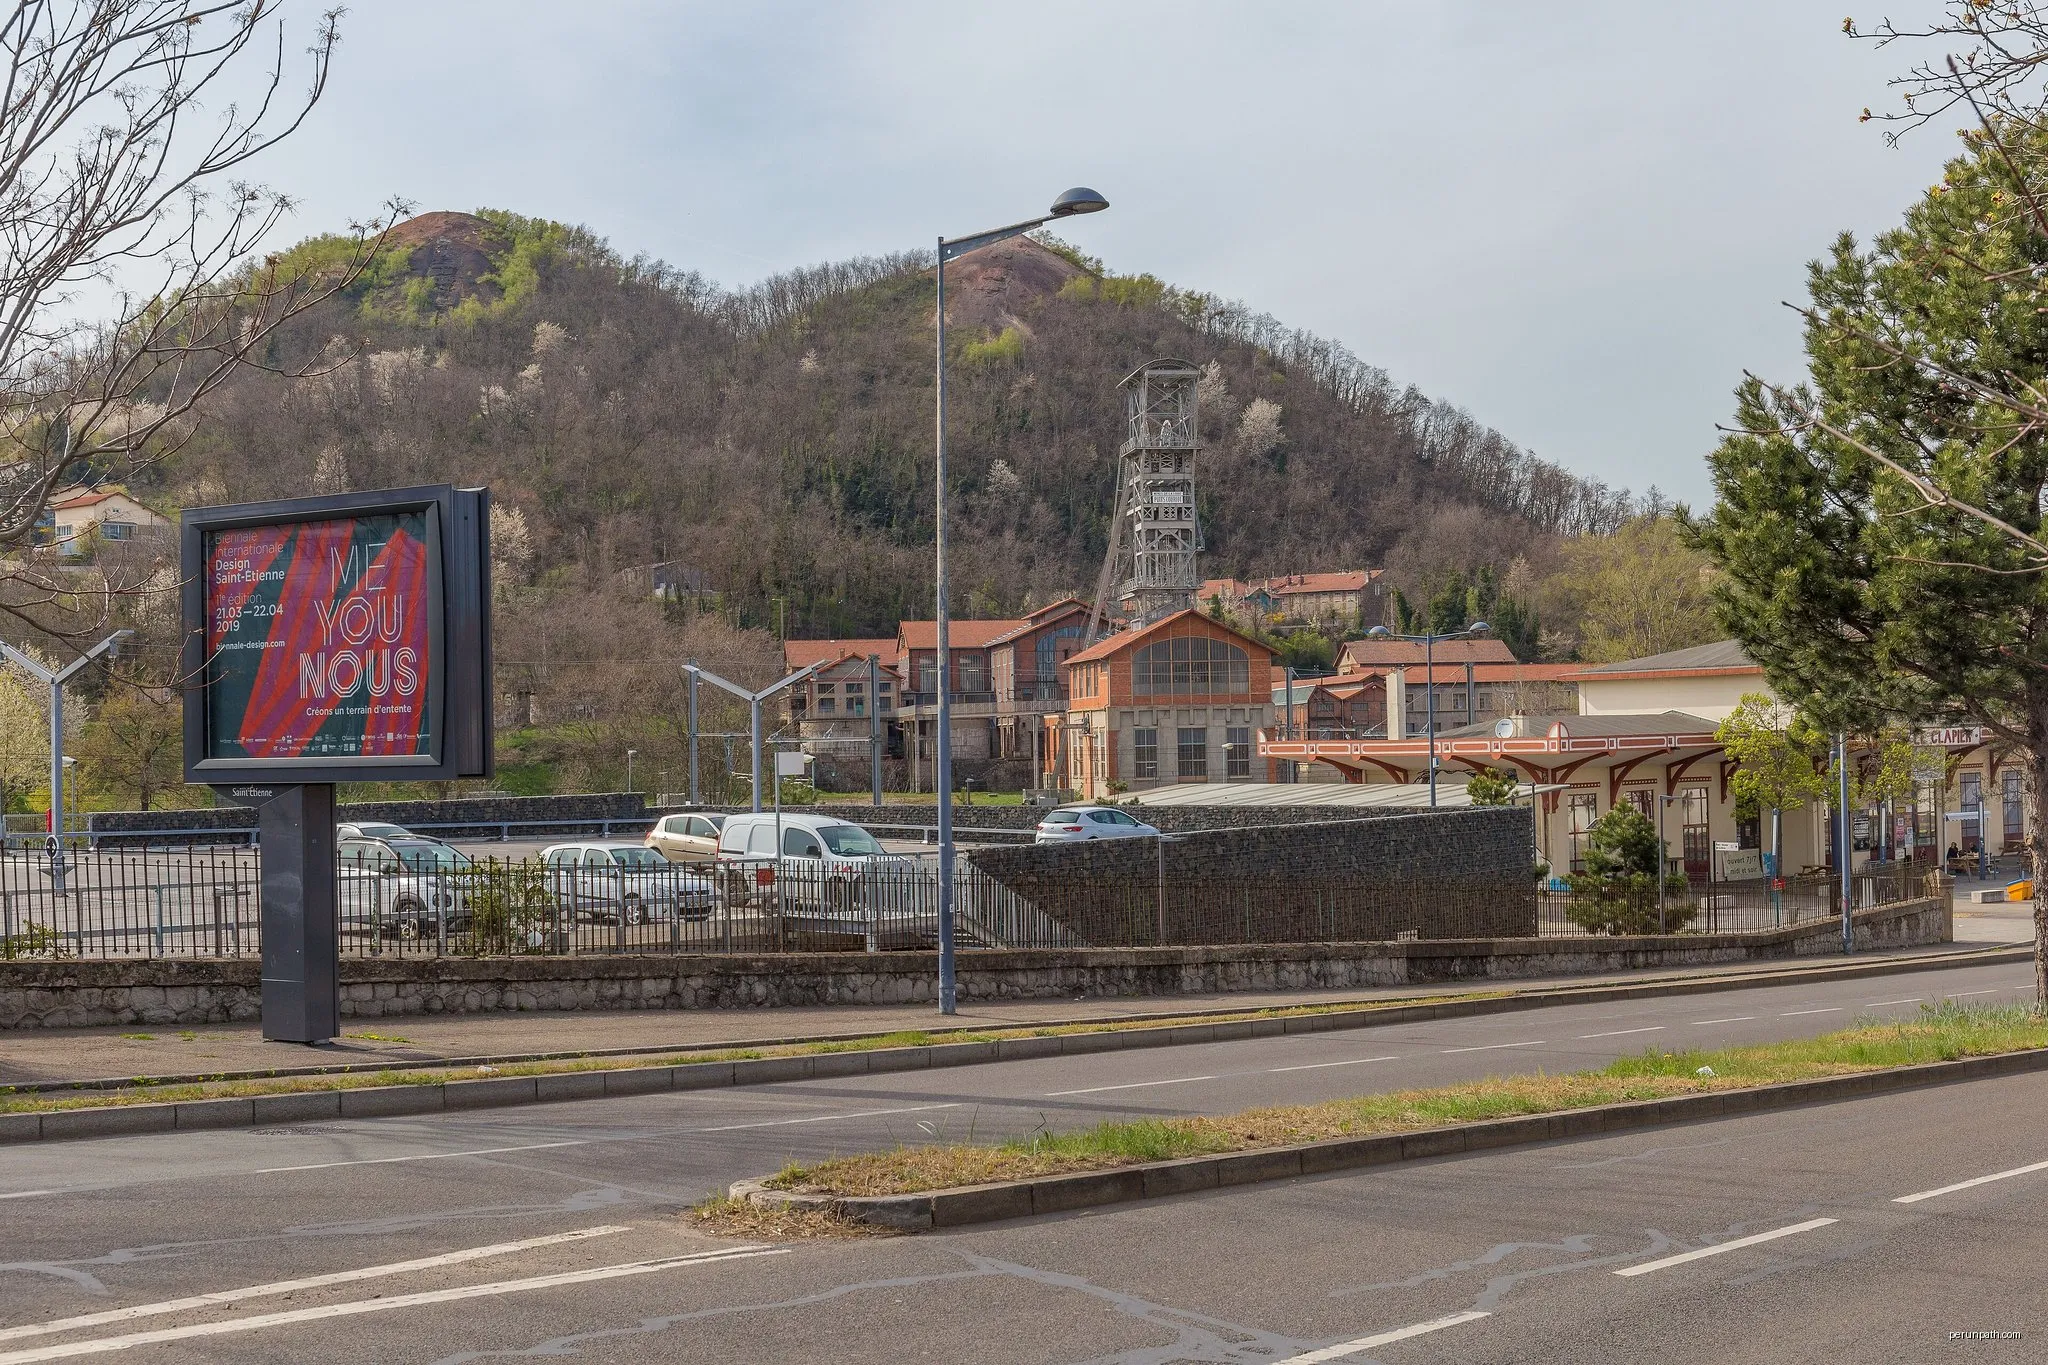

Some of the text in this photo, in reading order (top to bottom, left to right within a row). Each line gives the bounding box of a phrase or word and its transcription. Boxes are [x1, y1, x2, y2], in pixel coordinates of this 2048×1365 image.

[215, 531, 258, 545] Biennale
[215, 543, 284, 558] Internationale
[215, 559, 250, 571] Design
[331, 542, 387, 593] ME
[215, 569, 285, 584] Saint-Étienne
[228, 593, 262, 605] édition
[216, 620, 240, 632] 2019
[314, 594, 402, 646] YOU
[300, 647, 418, 699] NOUS
[306, 704, 412, 716] Créons un terrain d'entente
[1931, 729, 1972, 744] CLAPIER
